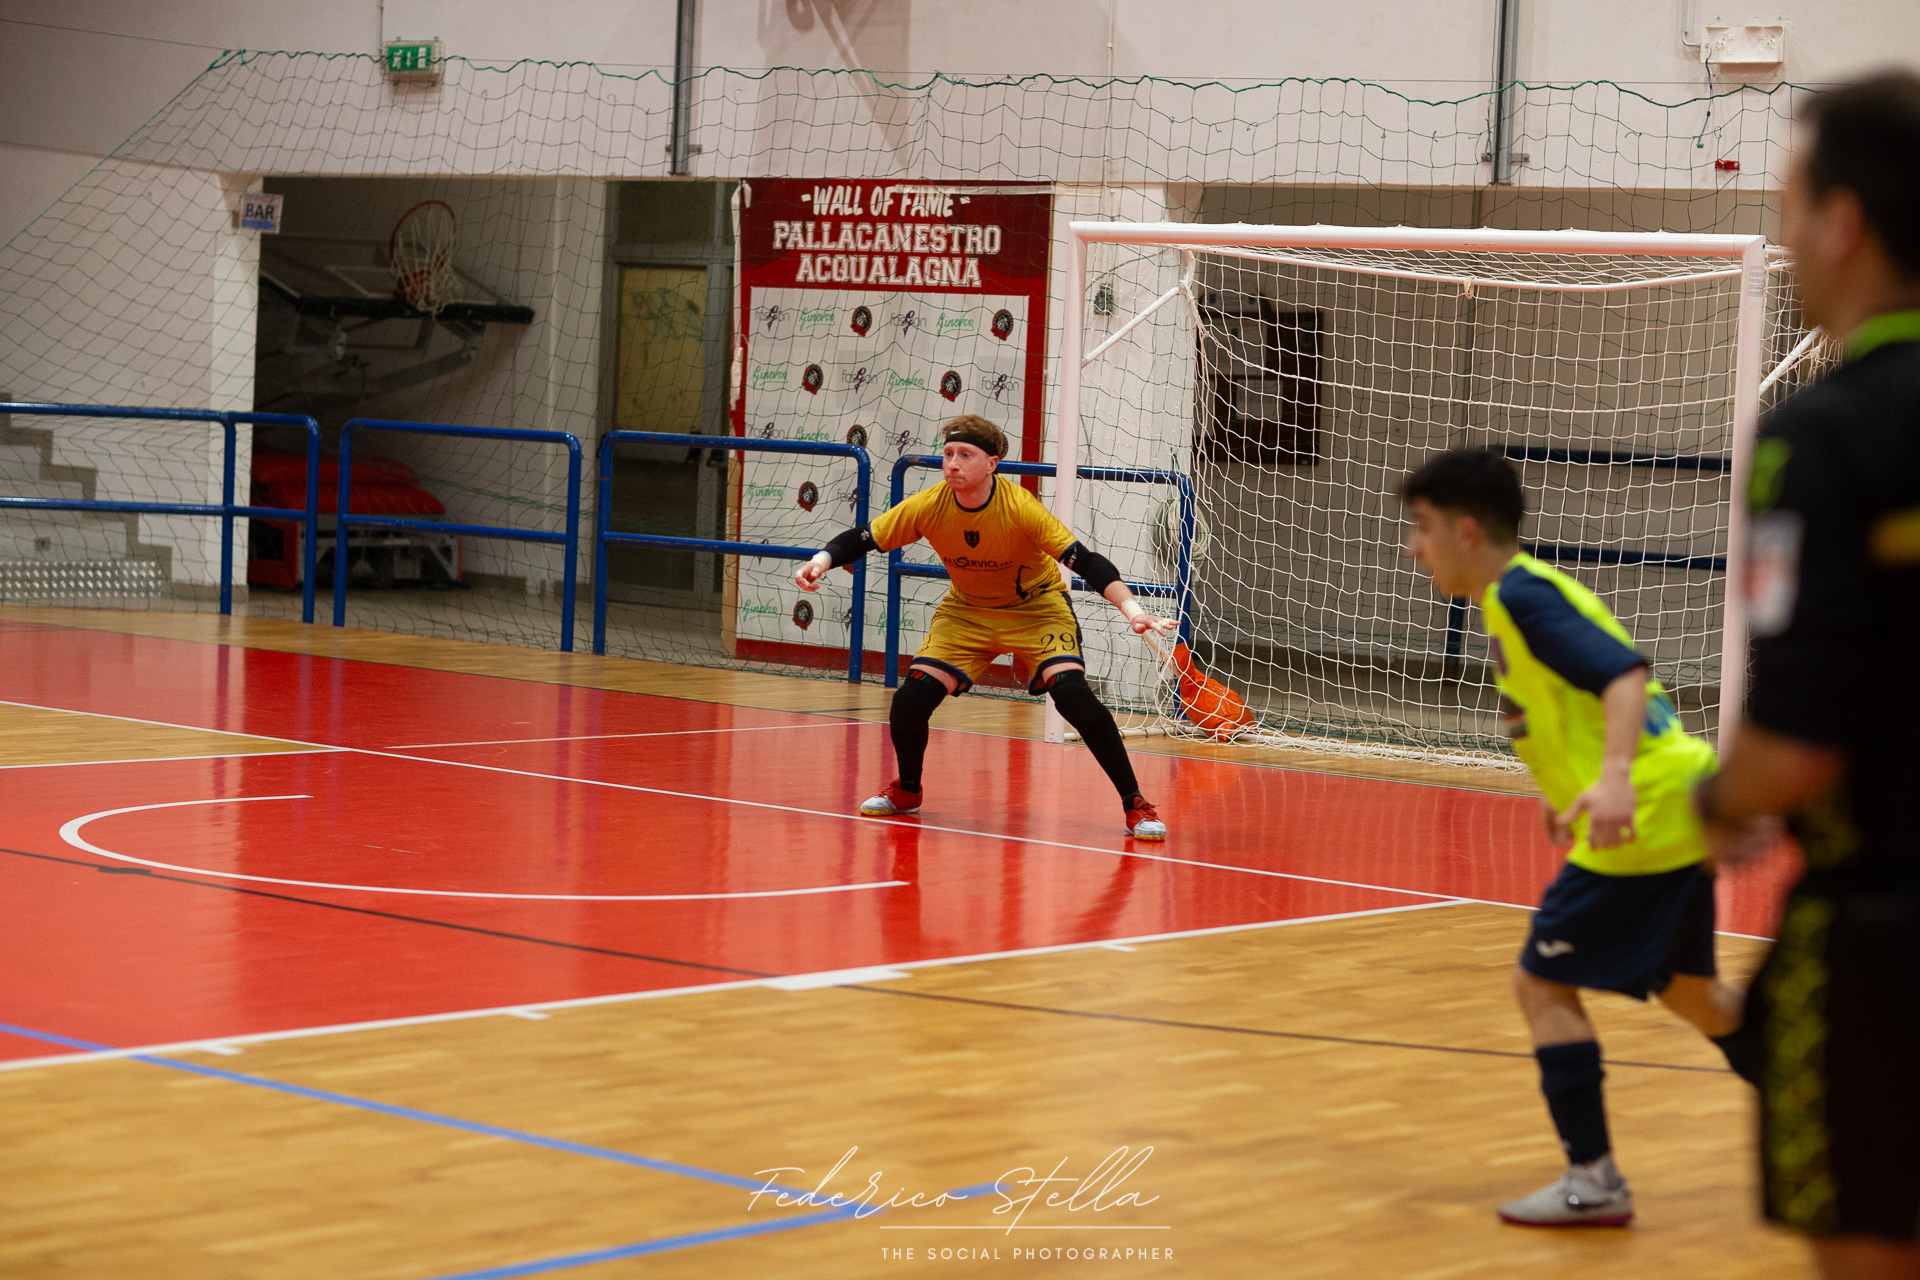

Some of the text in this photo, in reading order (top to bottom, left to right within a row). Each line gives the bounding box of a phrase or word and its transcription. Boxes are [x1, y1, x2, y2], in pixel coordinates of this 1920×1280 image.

[246, 203, 275, 219] BAR
[870, 185, 894, 217] OF
[773, 220, 1002, 254] PALLACANESTRO
[796, 253, 982, 287] ACQUALAGNA
[1040, 632, 1076, 654] 29
